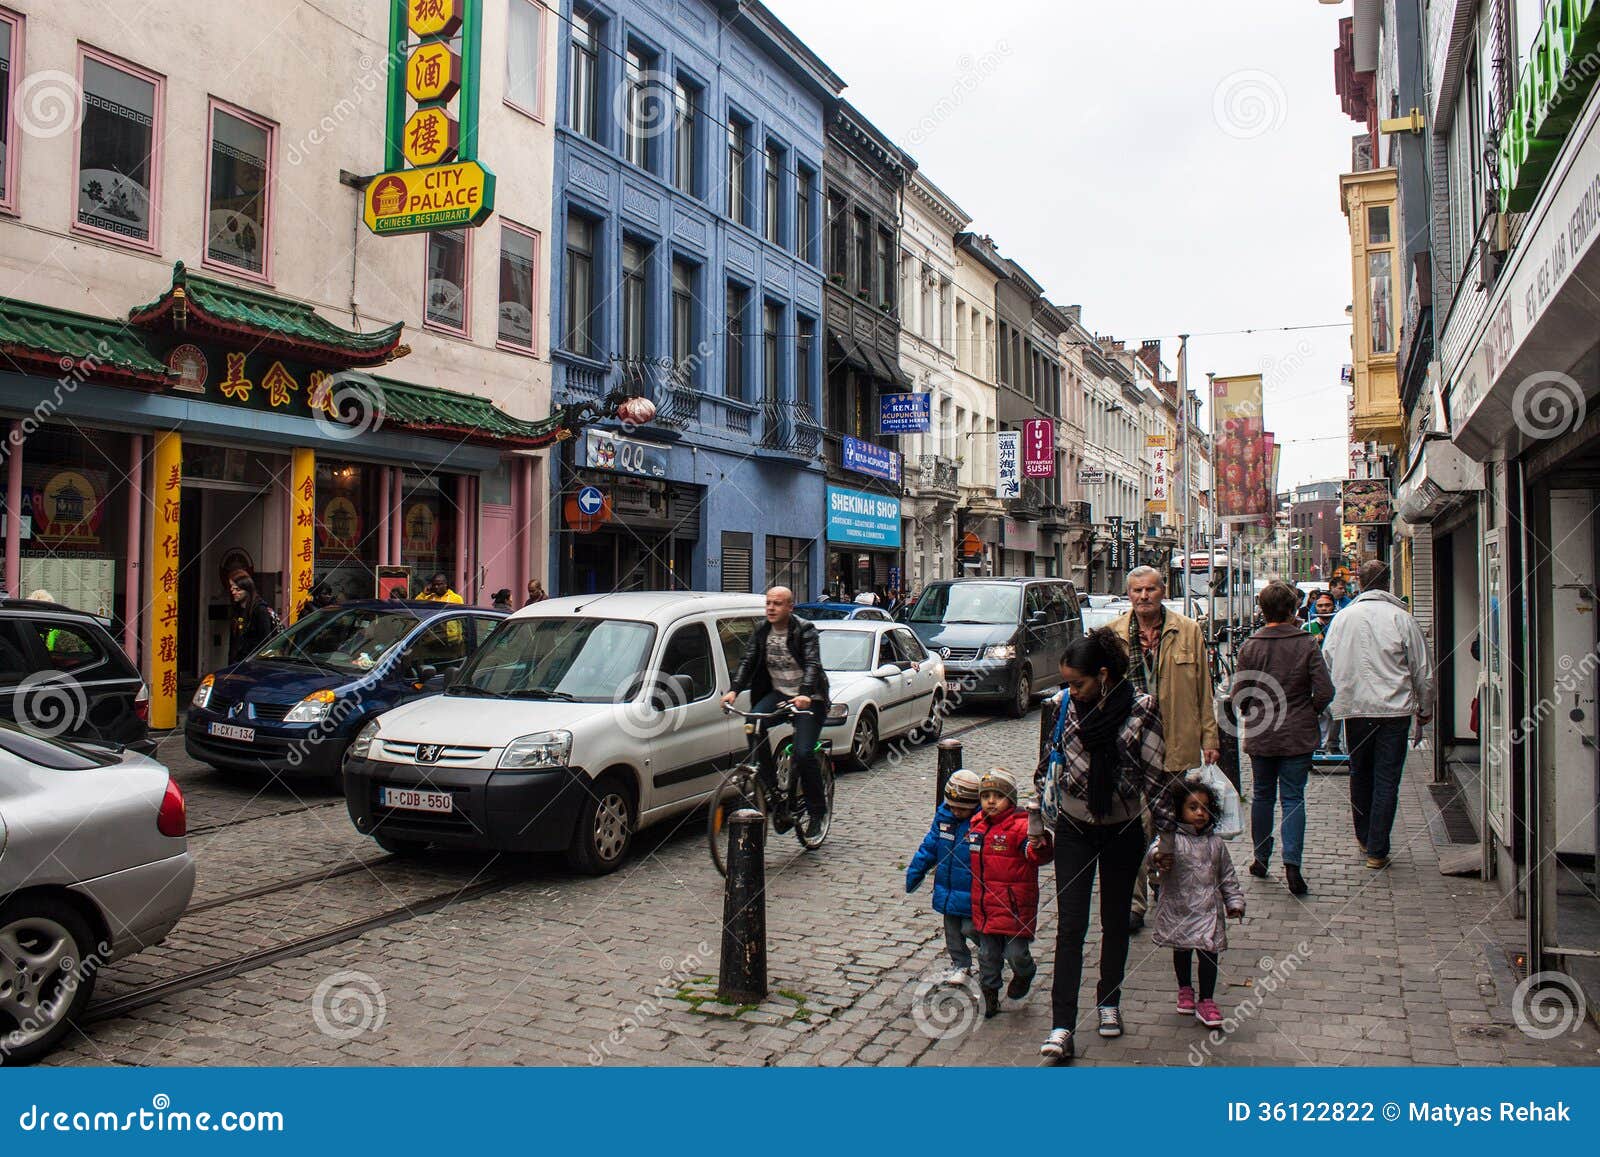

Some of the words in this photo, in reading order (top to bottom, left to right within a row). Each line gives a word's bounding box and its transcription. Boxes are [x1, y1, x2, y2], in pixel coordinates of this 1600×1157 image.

[424, 169, 464, 190] CITY
[409, 186, 478, 212] PALACE
[378, 215, 412, 229] CHINEES
[414, 209, 467, 225] RESTAURANT
[220, 352, 339, 418] 美食城
[892, 404, 919, 412] RENJI
[1034, 419, 1043, 460] FUJI
[621, 444, 647, 476] QQ
[1026, 464, 1052, 473] SUSHI
[831, 492, 875, 516] SHEKINAH
[876, 500, 898, 519] SHOP
